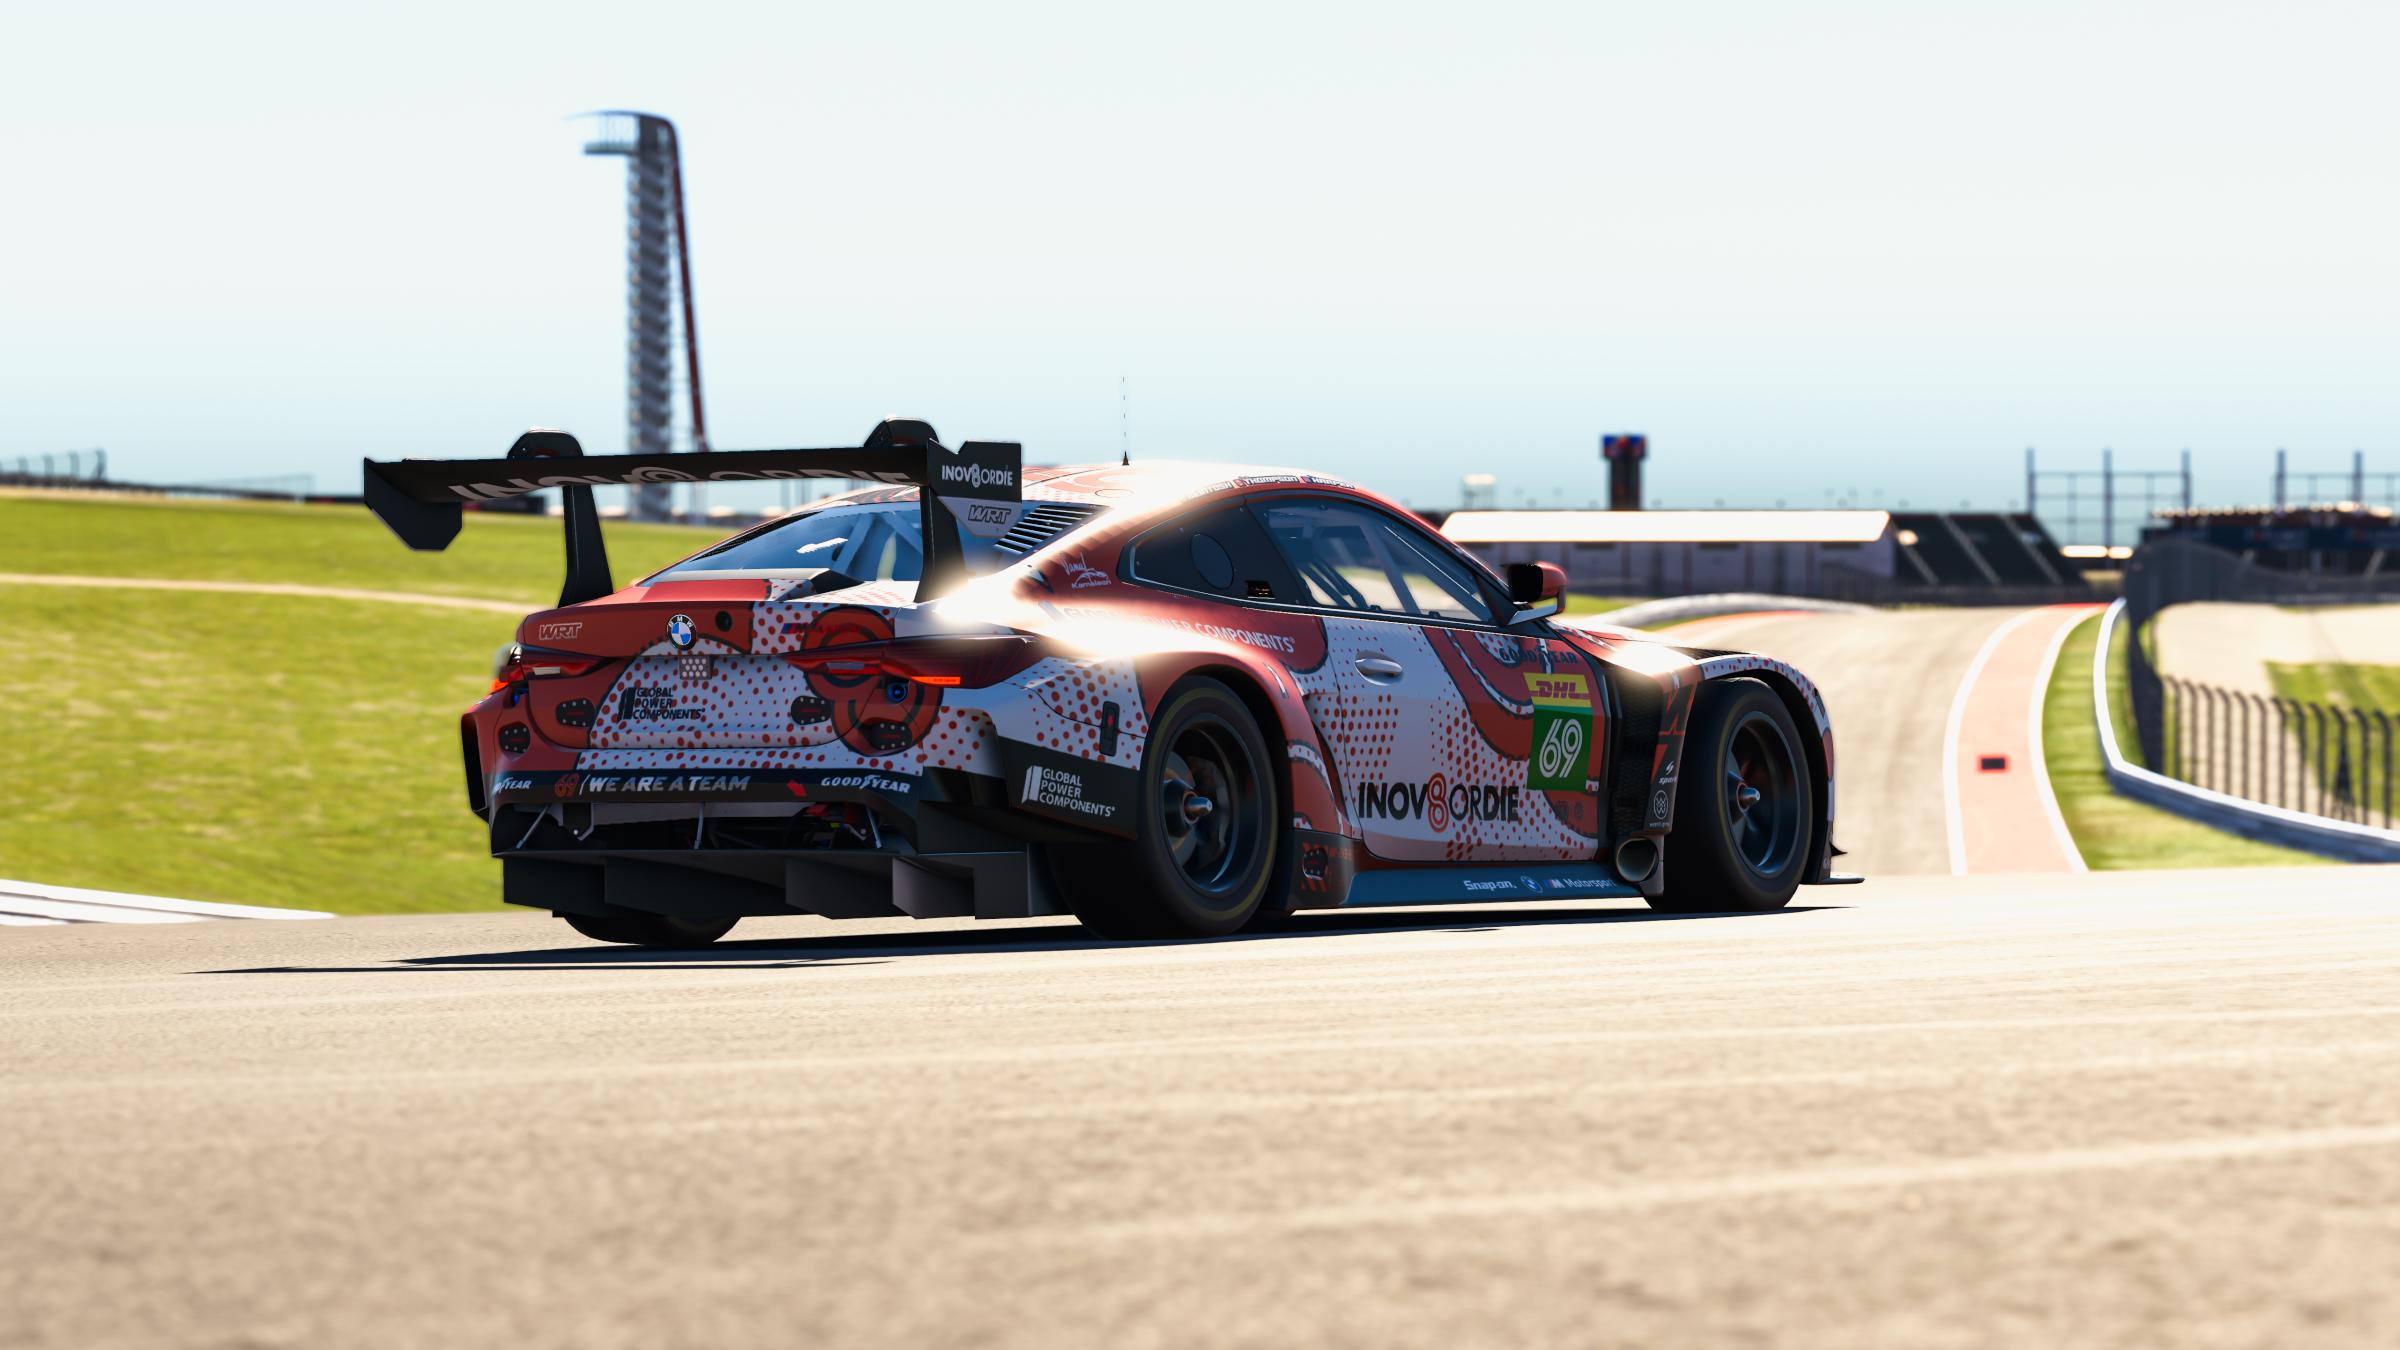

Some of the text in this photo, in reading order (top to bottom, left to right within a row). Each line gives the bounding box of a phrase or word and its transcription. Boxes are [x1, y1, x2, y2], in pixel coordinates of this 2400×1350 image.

[941, 463, 1013, 488] INOV8ORDIE
[1244, 476, 1298, 485] THOMPSON
[968, 504, 1011, 524] WRT
[539, 622, 582, 640] WRT
[636, 687, 673, 697] GLOBAL
[1535, 680, 1580, 699] DHL
[635, 698, 673, 708] POWER
[1539, 719, 1582, 778] 69
[589, 776, 616, 792] WE
[620, 776, 664, 792] ARE
[669, 776, 684, 792] A
[688, 775, 751, 792] TEAM
[821, 774, 911, 793] GOODYEAR
[1043, 768, 1082, 787] GLOBAL
[1041, 780, 1081, 798] POWER
[1359, 772, 1519, 833] INOV8ORDIE
